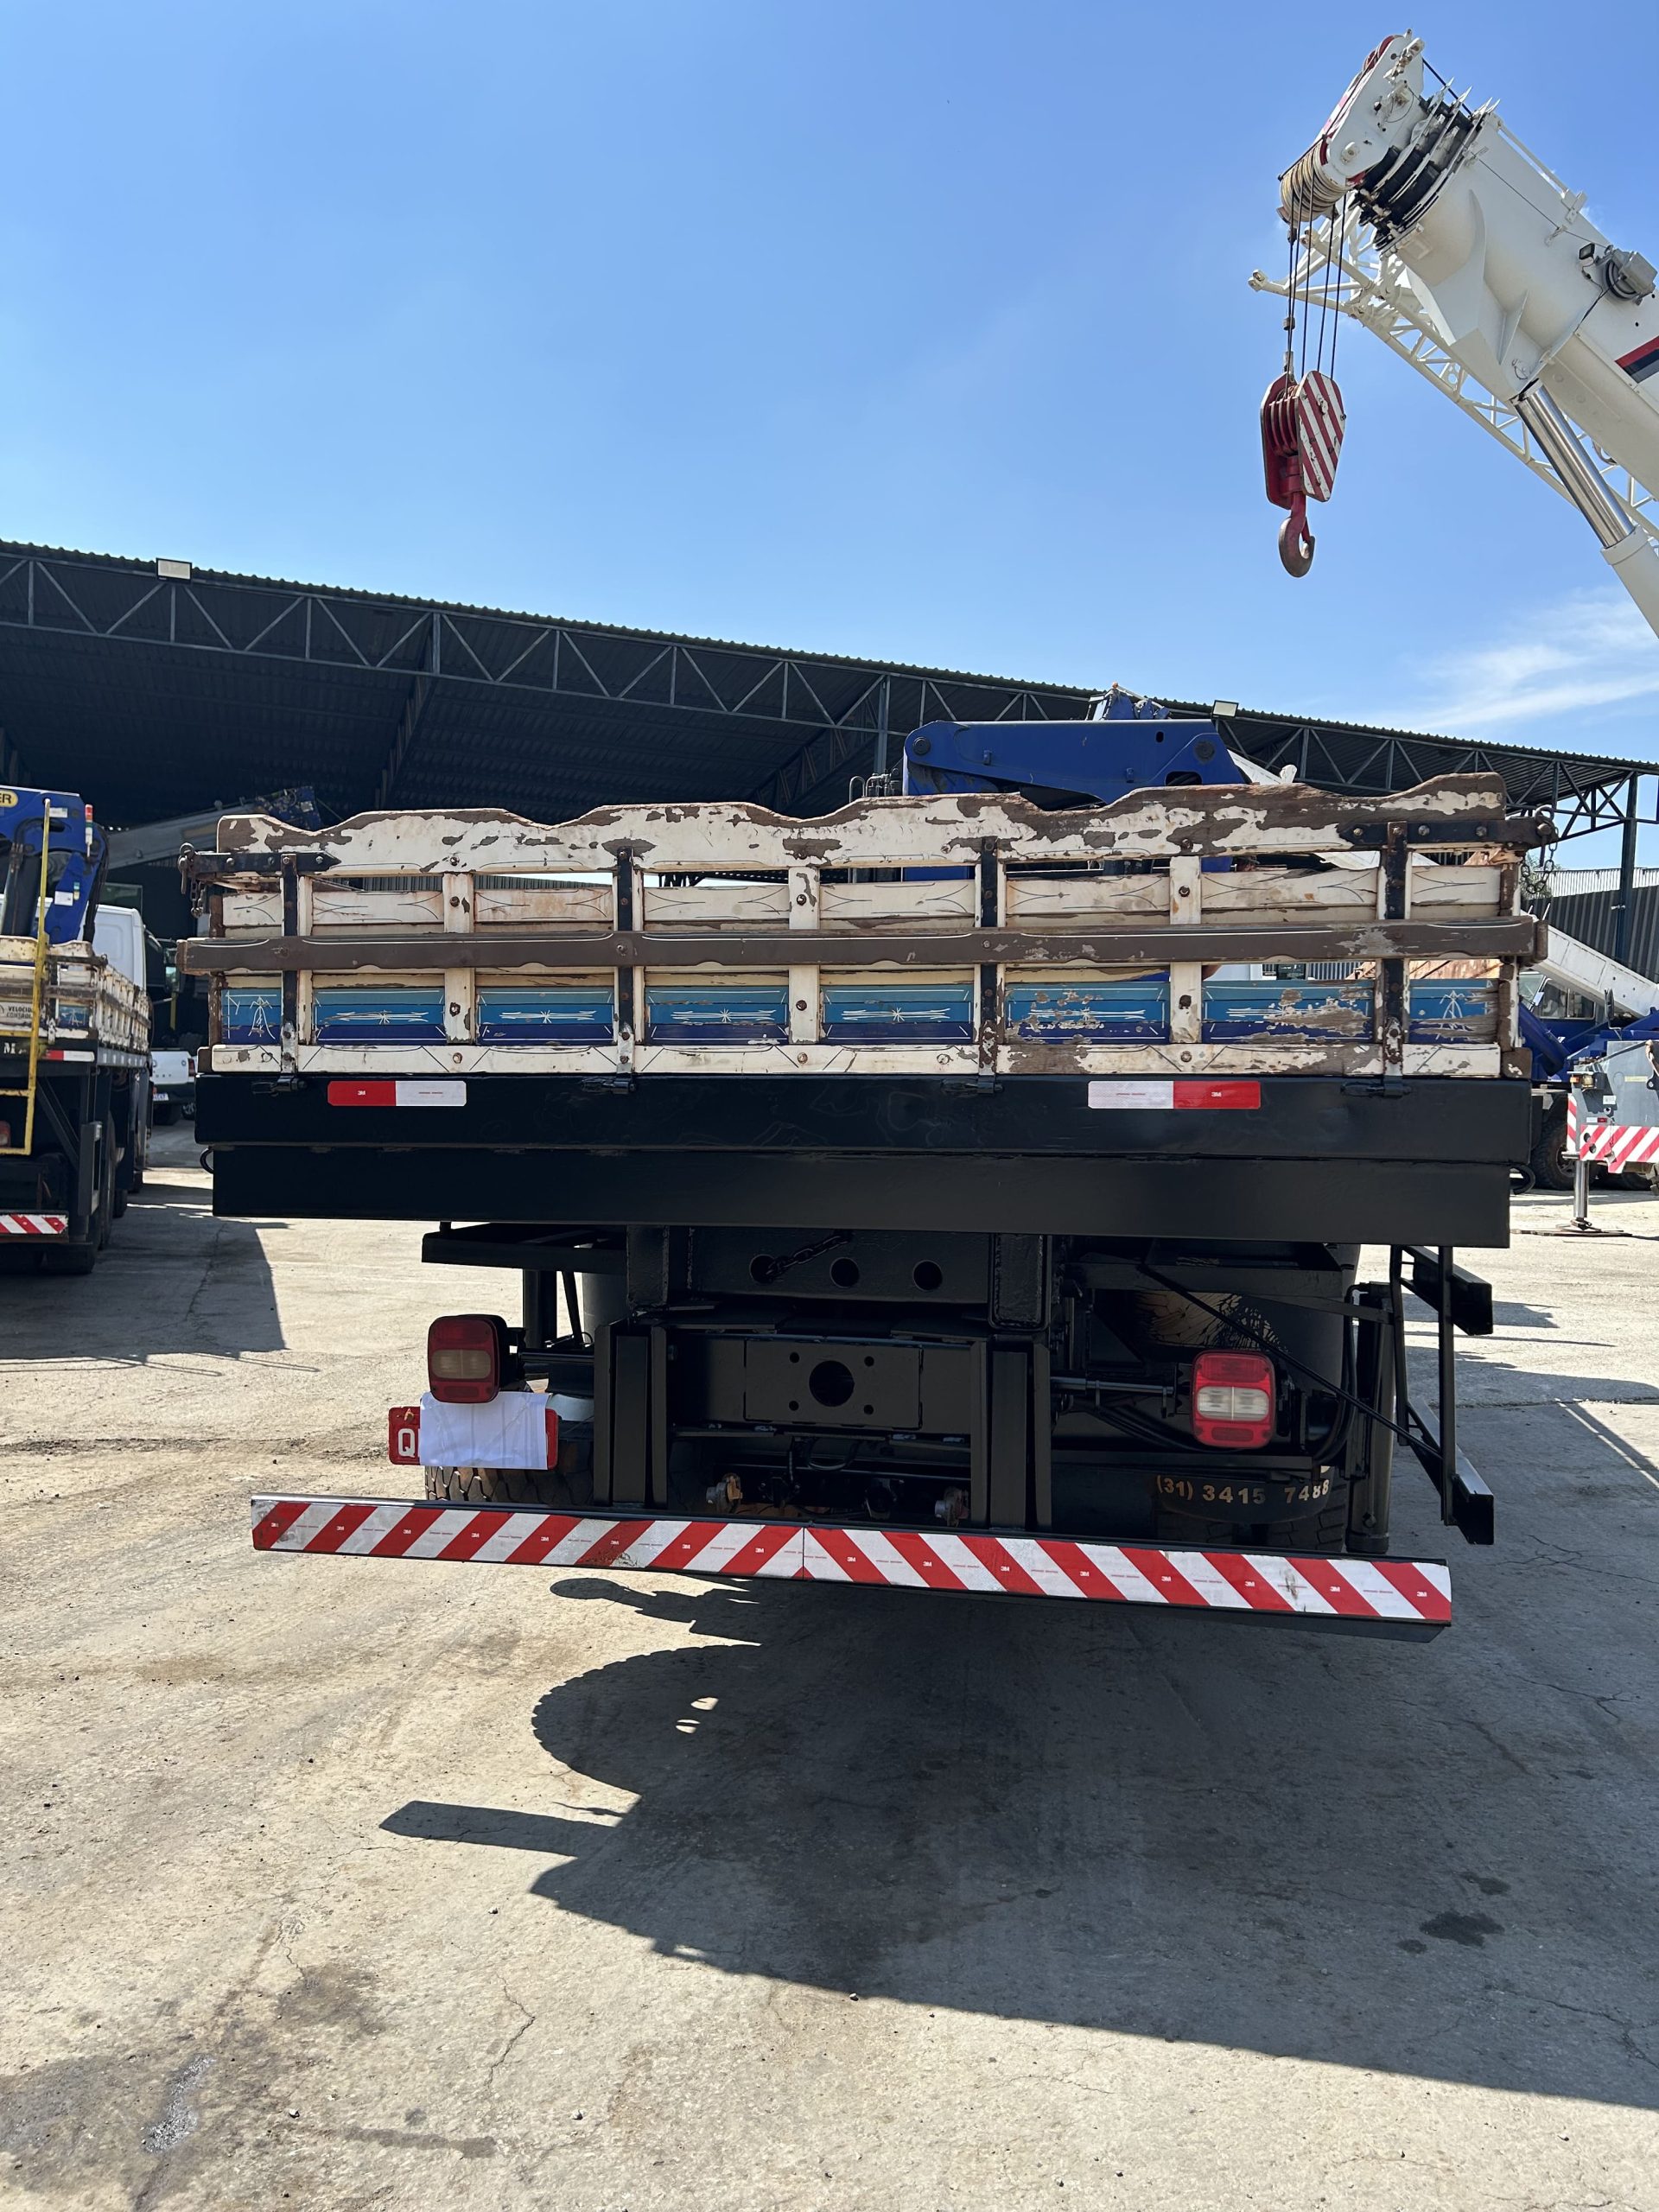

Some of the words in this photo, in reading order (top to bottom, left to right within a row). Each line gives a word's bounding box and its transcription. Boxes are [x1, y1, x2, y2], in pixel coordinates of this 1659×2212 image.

[398, 1428, 420, 1458] Q
[1157, 1474, 1193, 1501] (31)
[1203, 1484, 1266, 1504] 3415
[1284, 1479, 1330, 1503] 7488
